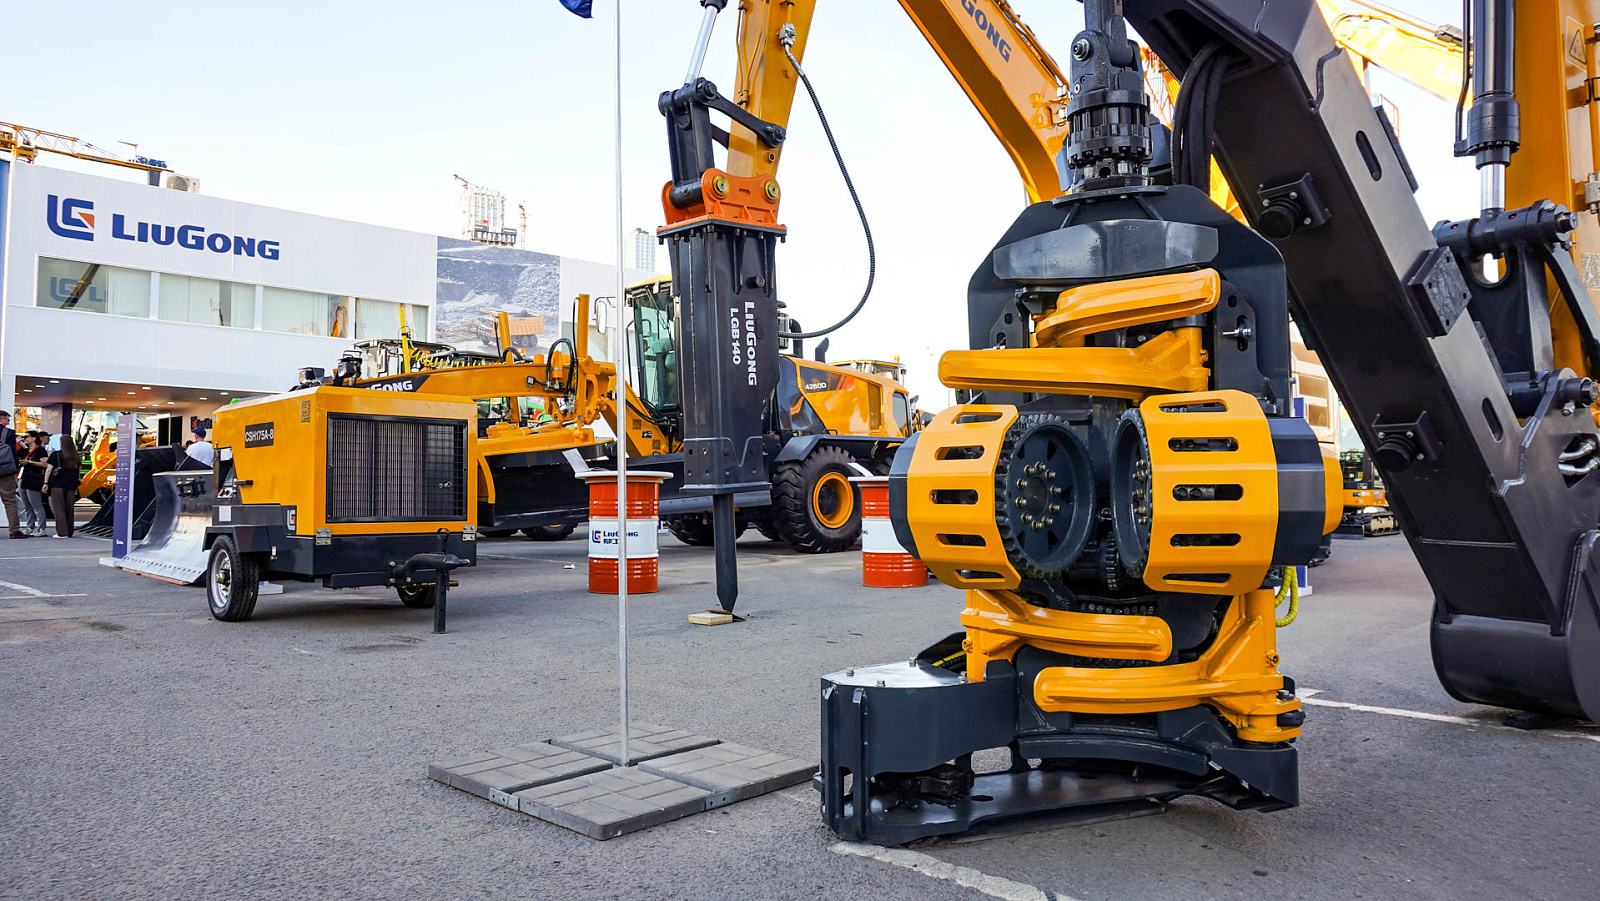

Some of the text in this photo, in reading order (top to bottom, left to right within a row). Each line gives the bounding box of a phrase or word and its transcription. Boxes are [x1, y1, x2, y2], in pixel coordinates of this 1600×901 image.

[961, 0, 1012, 63] GONG
[744, 301, 757, 386] LIUGONG
[245, 429, 274, 442] CSH175A-8
